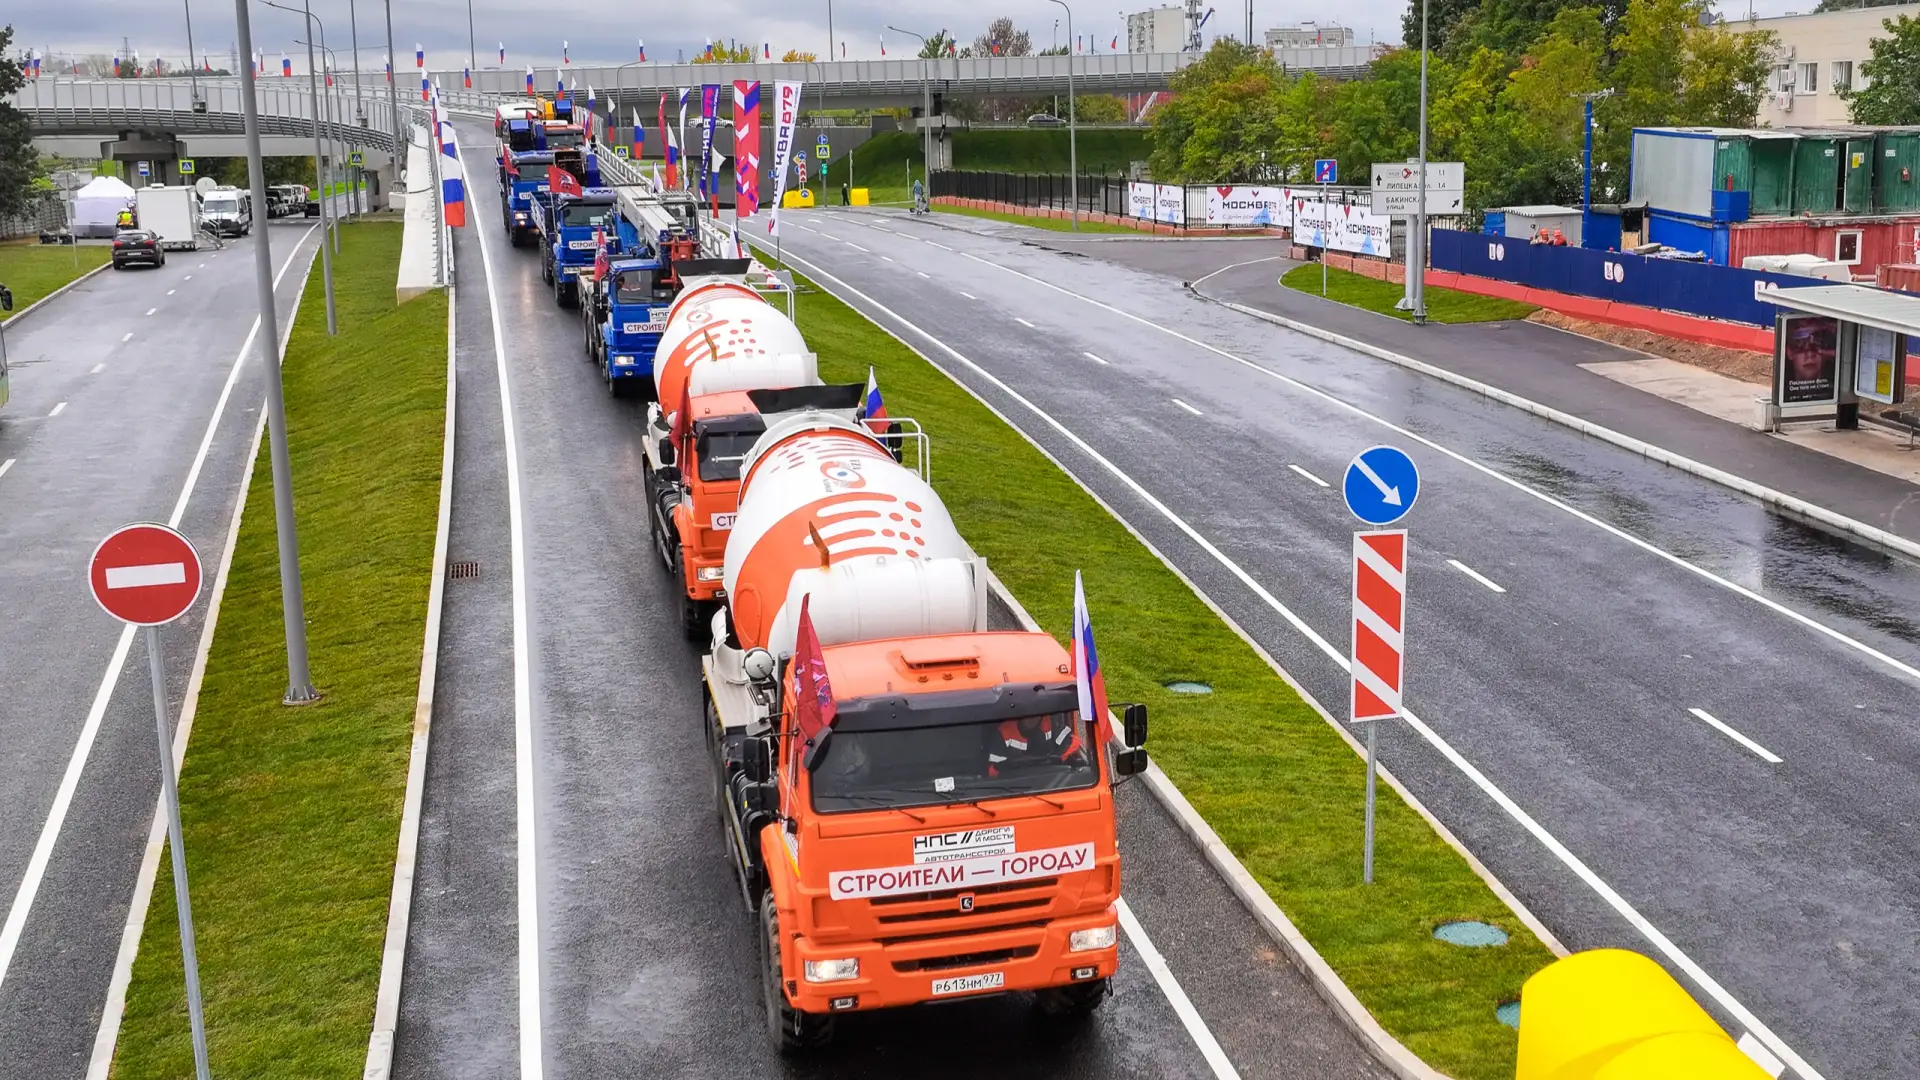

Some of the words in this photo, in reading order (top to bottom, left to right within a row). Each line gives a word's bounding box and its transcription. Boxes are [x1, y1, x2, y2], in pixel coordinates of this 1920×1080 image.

[1386, 182, 1421, 190] ЛИПЕЦКА
[1386, 204, 1405, 212] улица
[975, 827, 1011, 837] ДОРОГИ
[982, 833, 1014, 843] МОСТЫ
[925, 848, 1006, 863] АВТОТРАНССТРОЙ
[837, 865, 965, 894] СТРОИТЕЛИ
[1001, 848, 1088, 877] ГОРОДУ
[983, 973, 1001, 984] 977
